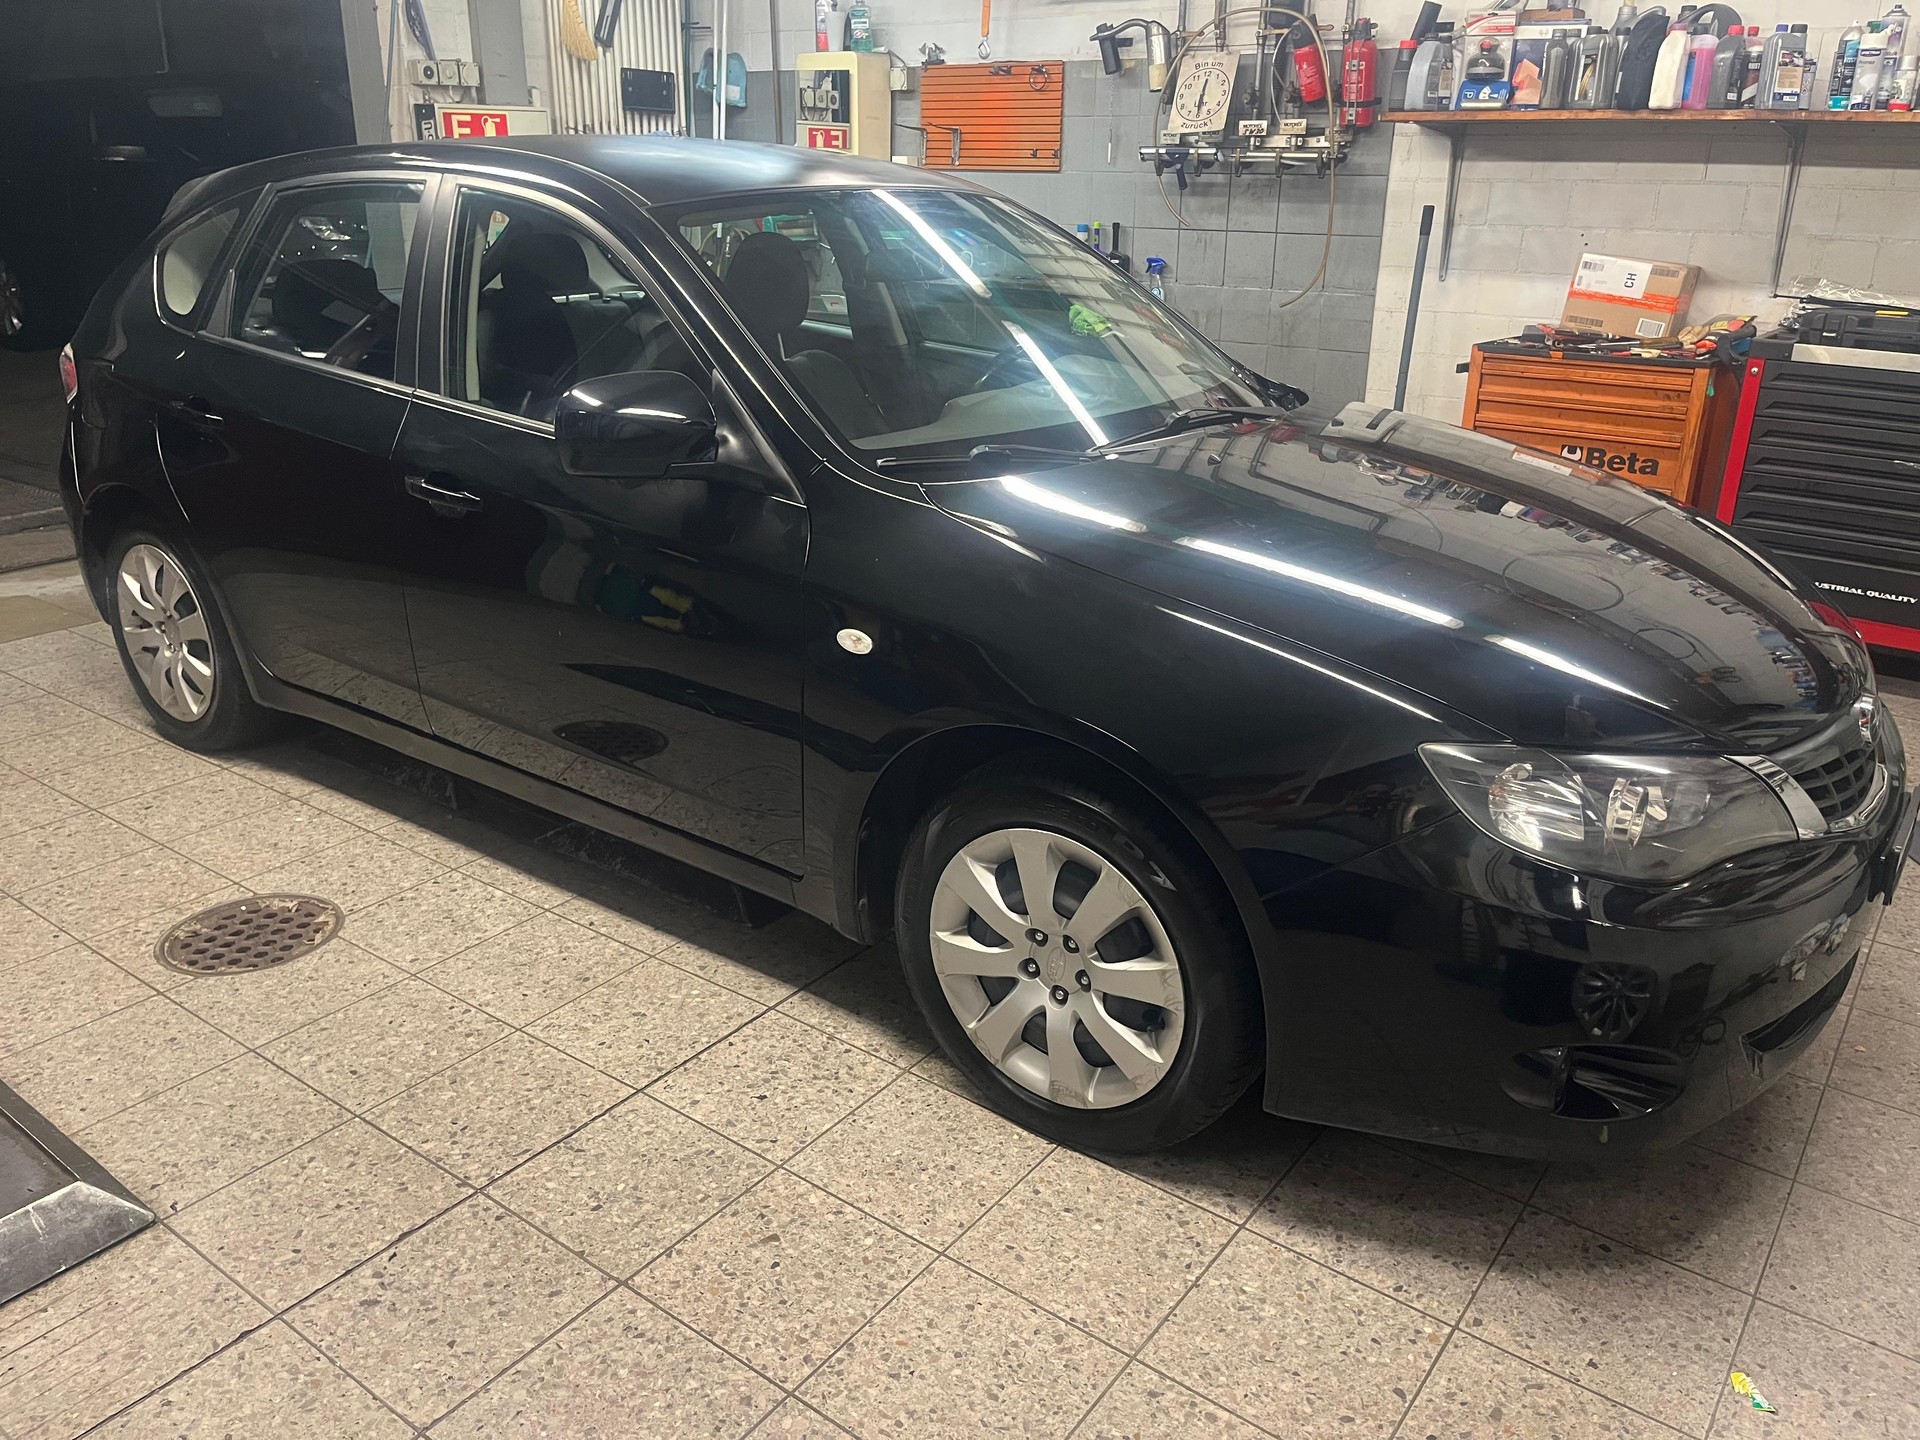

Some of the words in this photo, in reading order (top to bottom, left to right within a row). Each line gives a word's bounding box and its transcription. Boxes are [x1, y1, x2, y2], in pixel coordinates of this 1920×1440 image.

[1195, 61, 1209, 70] Bin
[1624, 273, 1637, 288] CH
[1585, 447, 1660, 476] Beta
[1866, 590, 1918, 604] QUALITY
